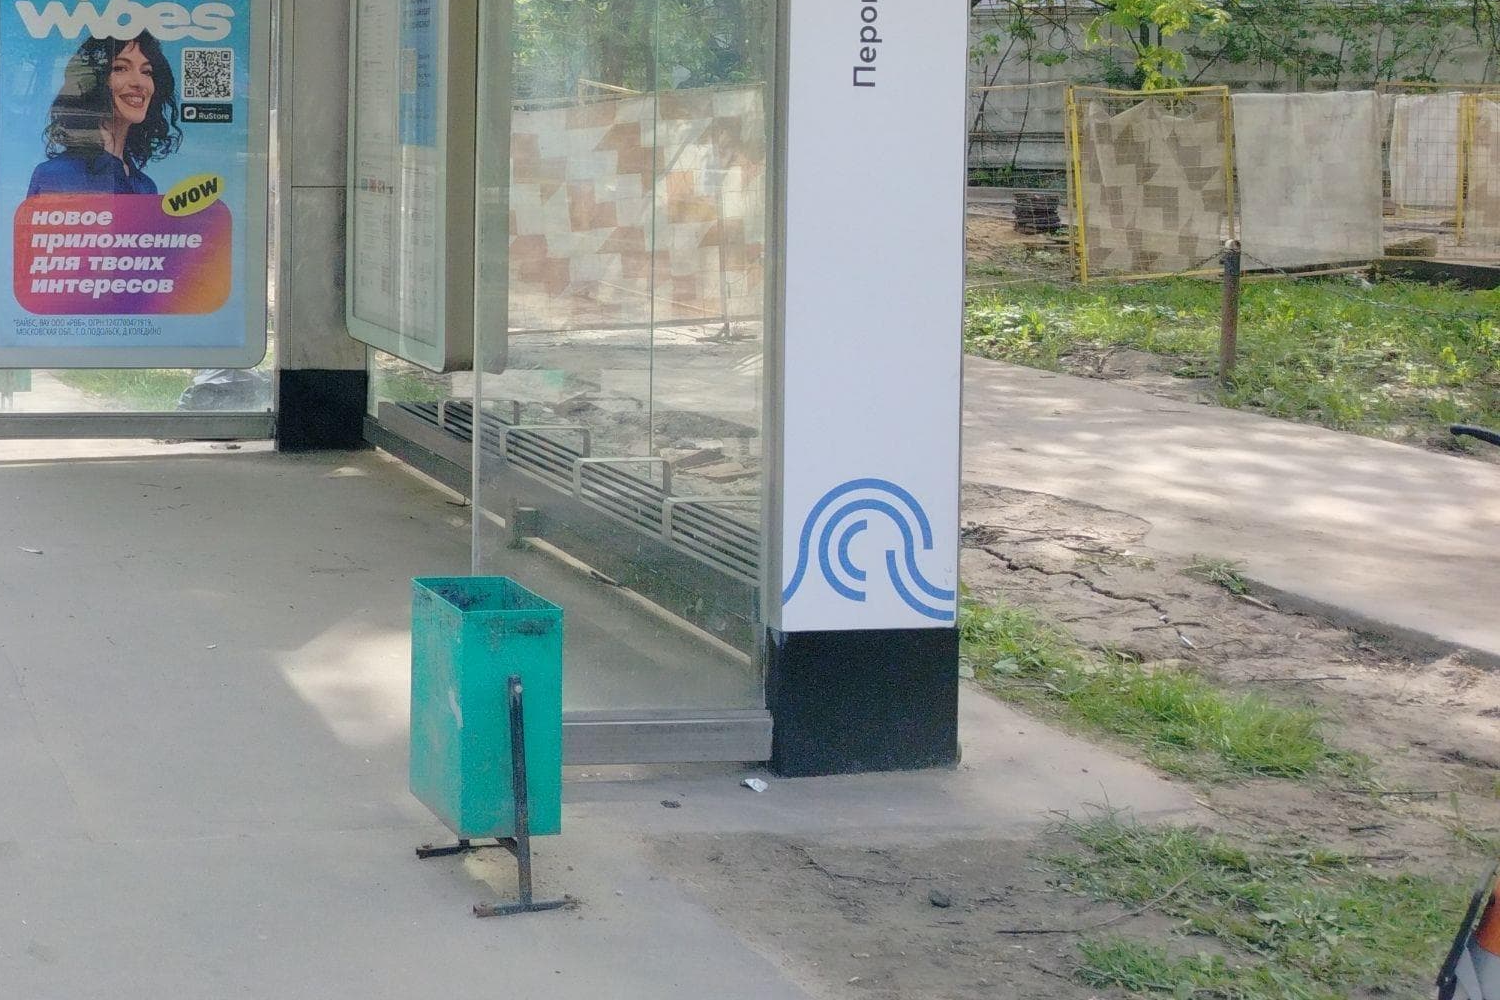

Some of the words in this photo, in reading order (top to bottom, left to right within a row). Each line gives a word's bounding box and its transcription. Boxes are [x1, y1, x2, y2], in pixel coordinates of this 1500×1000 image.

[198, 112, 230, 120] RuStore
[31, 210, 113, 226] новое
[31, 233, 203, 253] приложение
[30, 256, 80, 274] для
[88, 256, 166, 271] твоих
[30, 278, 174, 298] интересов
